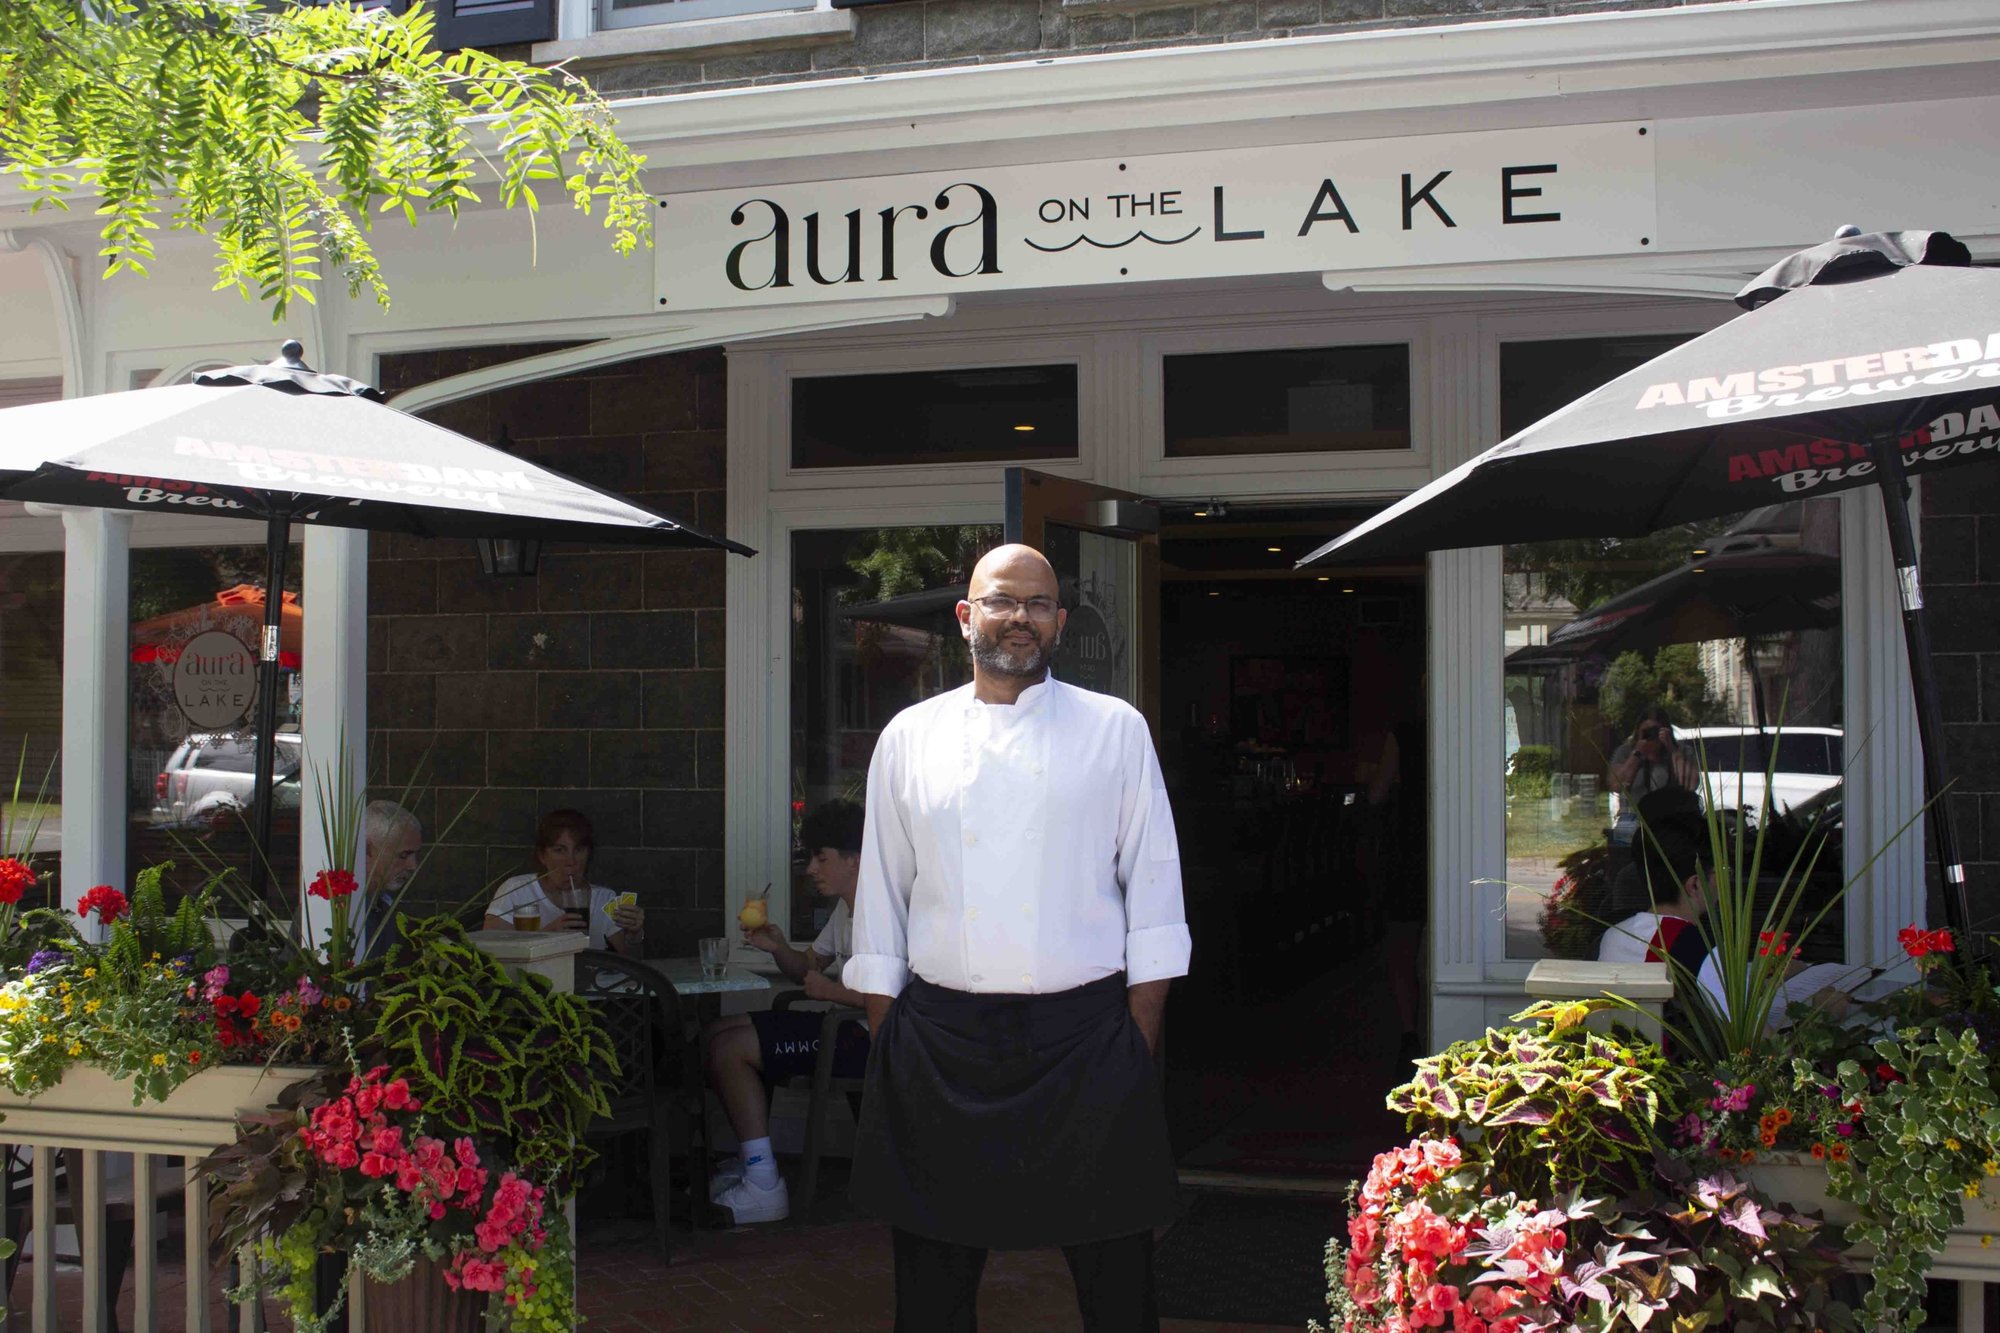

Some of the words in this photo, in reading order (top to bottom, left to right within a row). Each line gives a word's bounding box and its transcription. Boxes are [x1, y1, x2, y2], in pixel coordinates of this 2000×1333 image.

[725, 183, 1003, 291] aura
[1038, 197, 1090, 224] ON
[1106, 190, 1183, 218] THE
[1213, 163, 1561, 242] LAKE
[174, 436, 534, 491] AMSTERDAM
[227, 462, 505, 510] Brewery
[185, 652, 244, 675] aura
[185, 694, 244, 707] LAKE
[775, 1040, 820, 1055] OMMY
